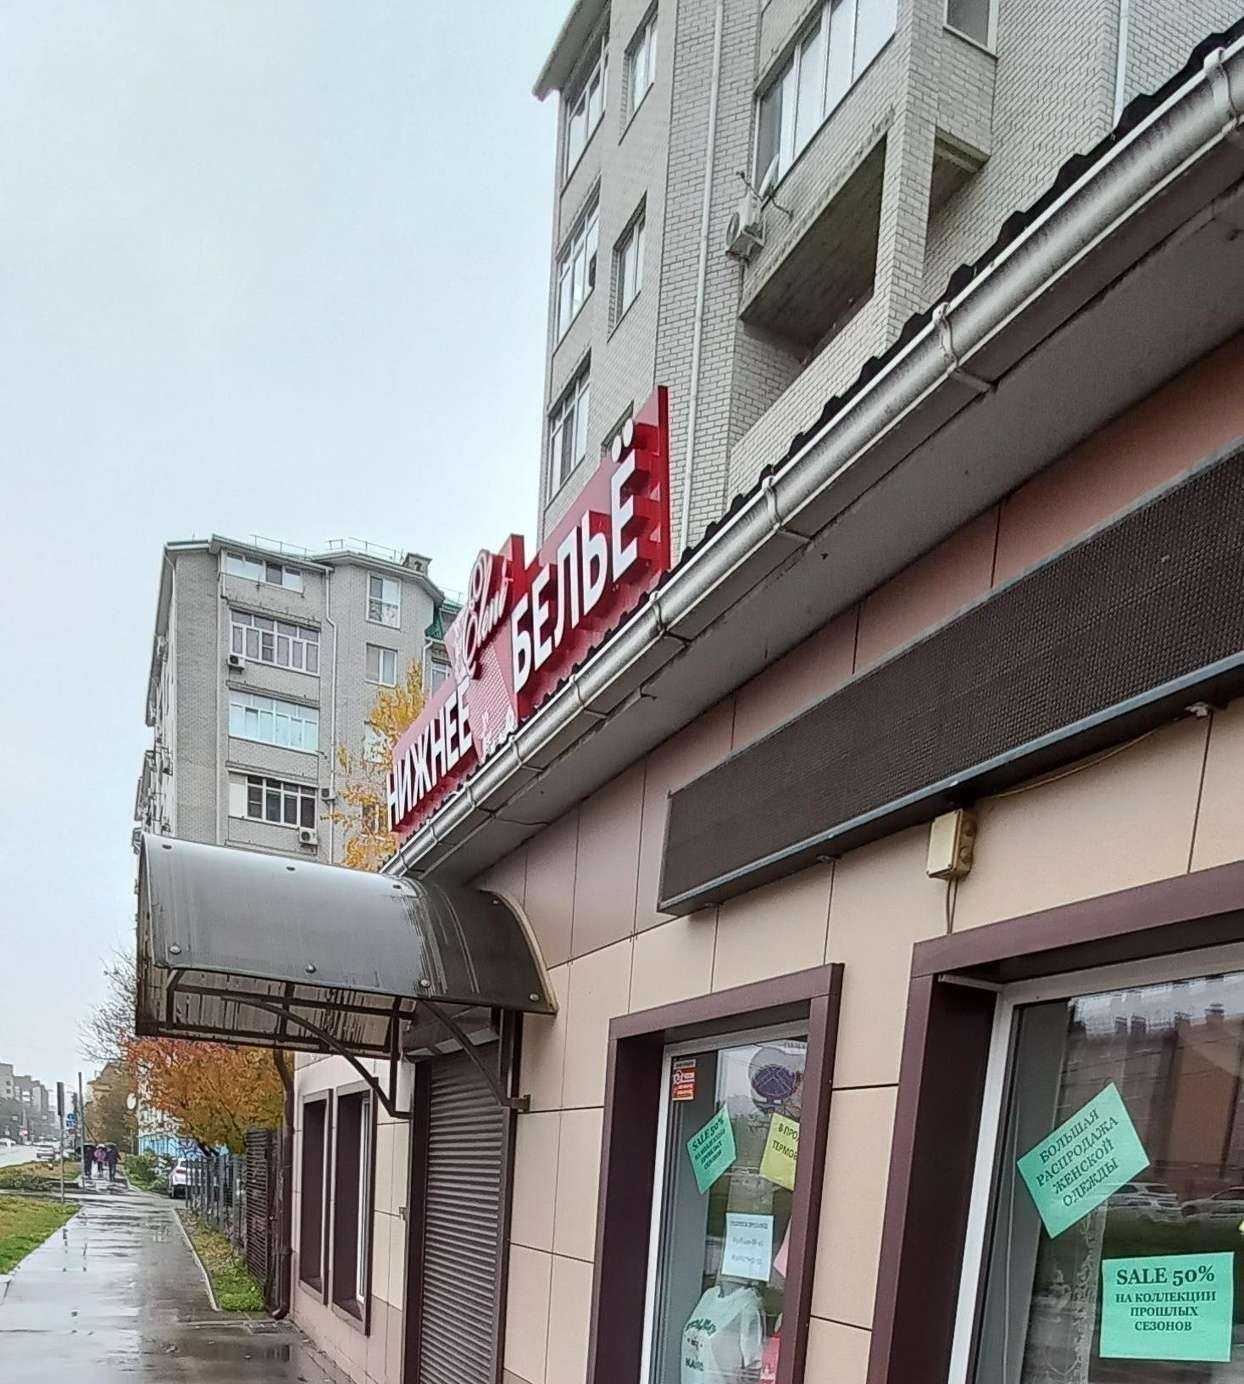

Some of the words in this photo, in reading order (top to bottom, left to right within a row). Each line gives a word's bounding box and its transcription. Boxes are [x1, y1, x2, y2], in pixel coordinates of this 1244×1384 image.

[386, 676, 473, 832] НИЖНЕЕ
[510, 417, 640, 694] БЕЛЬЁ
[783, 1125, 798, 1140] ПРО
[1040, 1107, 1100, 1164] БОЛЬШАЯ
[1036, 1116, 1119, 1187] РАСПРОДАЖА
[1053, 1137, 1115, 1195] ЖЕНСКОЙ
[1063, 1157, 1120, 1207] ОДЕЖДЫ
[1116, 1266, 1168, 1286] SALE
[1172, 1264, 1216, 1287] 50%
[1115, 1293, 1132, 1303] НА
[1135, 1290, 1217, 1304] КОЛЛЕКЦИИ
[1130, 1306, 1199, 1317] ПРОШЛЫХ
[1134, 1320, 1193, 1332] СЕЗОНОВ
